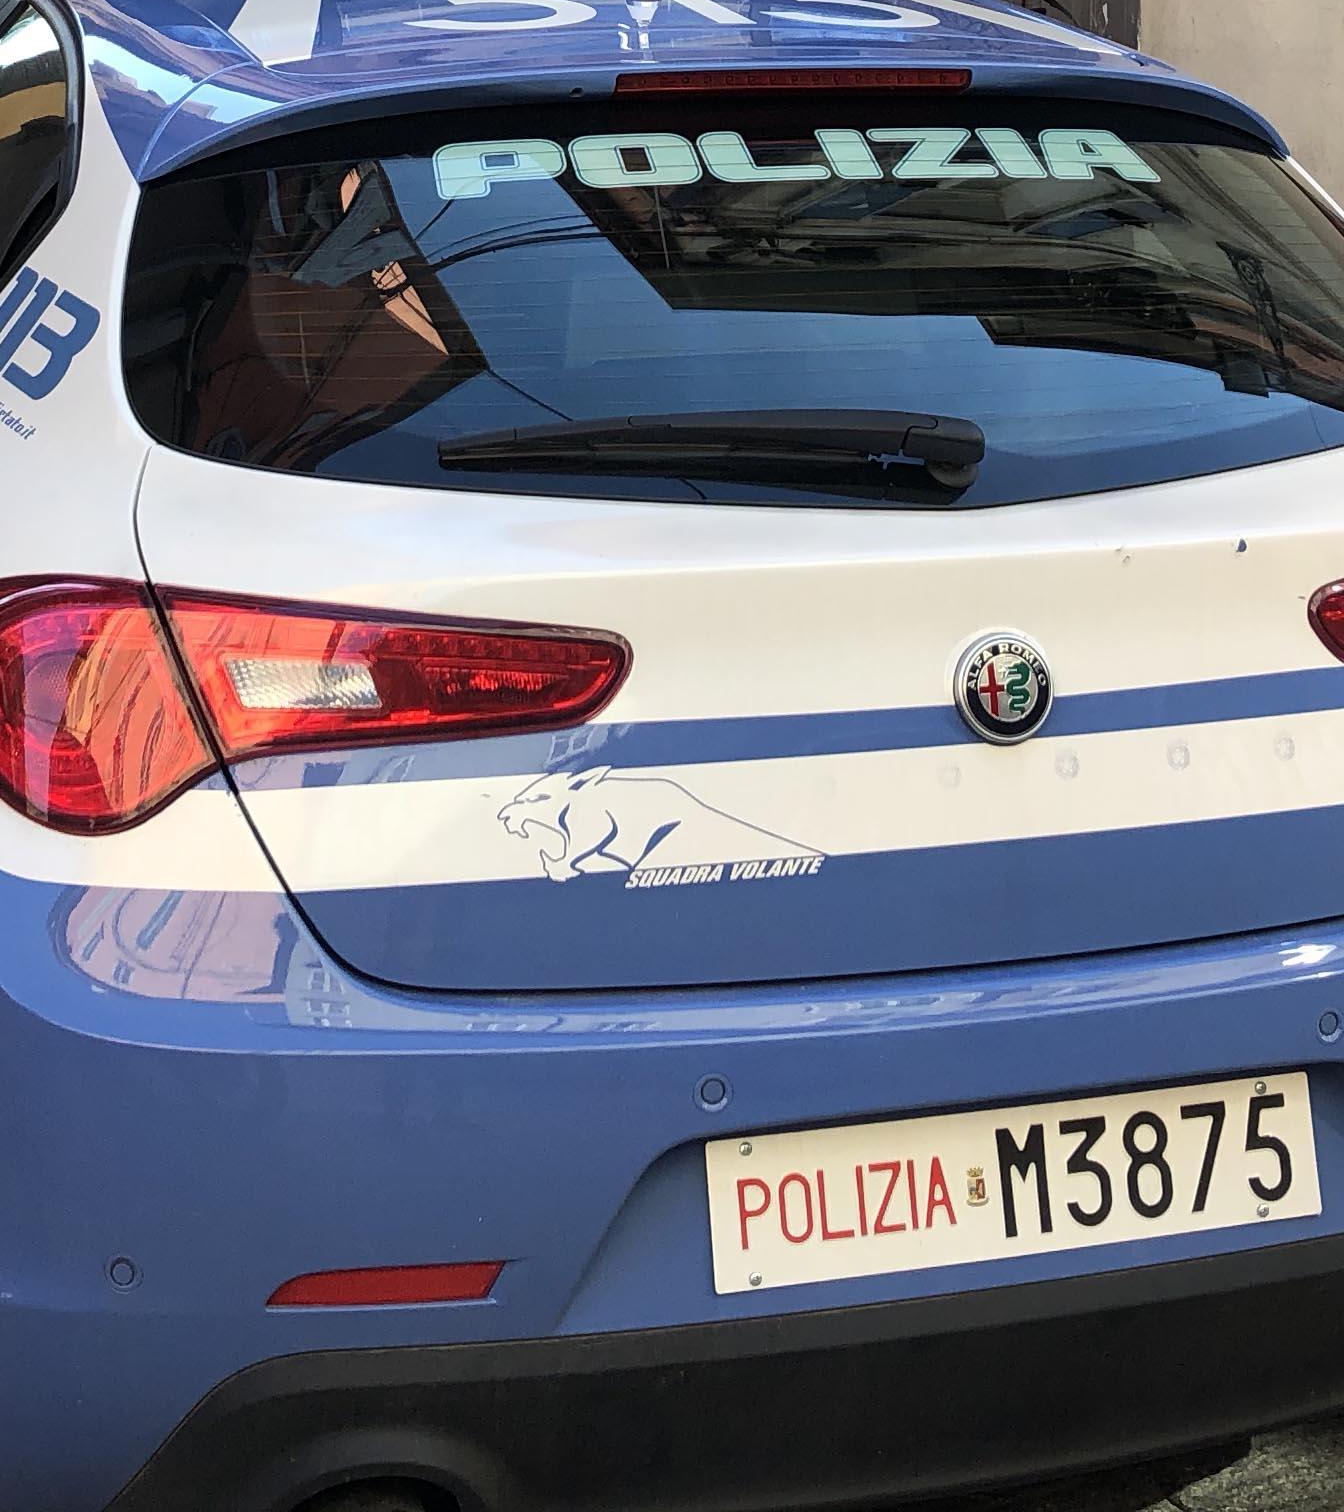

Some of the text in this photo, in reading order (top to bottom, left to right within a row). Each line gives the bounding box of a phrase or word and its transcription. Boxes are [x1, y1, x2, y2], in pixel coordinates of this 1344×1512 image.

[433, 126, 1162, 201] POLIZIA
[967, 642, 1048, 691] ALFA ROMEO
[625, 855, 826, 889] SQUADRA VOLANTE
[736, 1091, 1294, 1251] POLIZIA M3875
